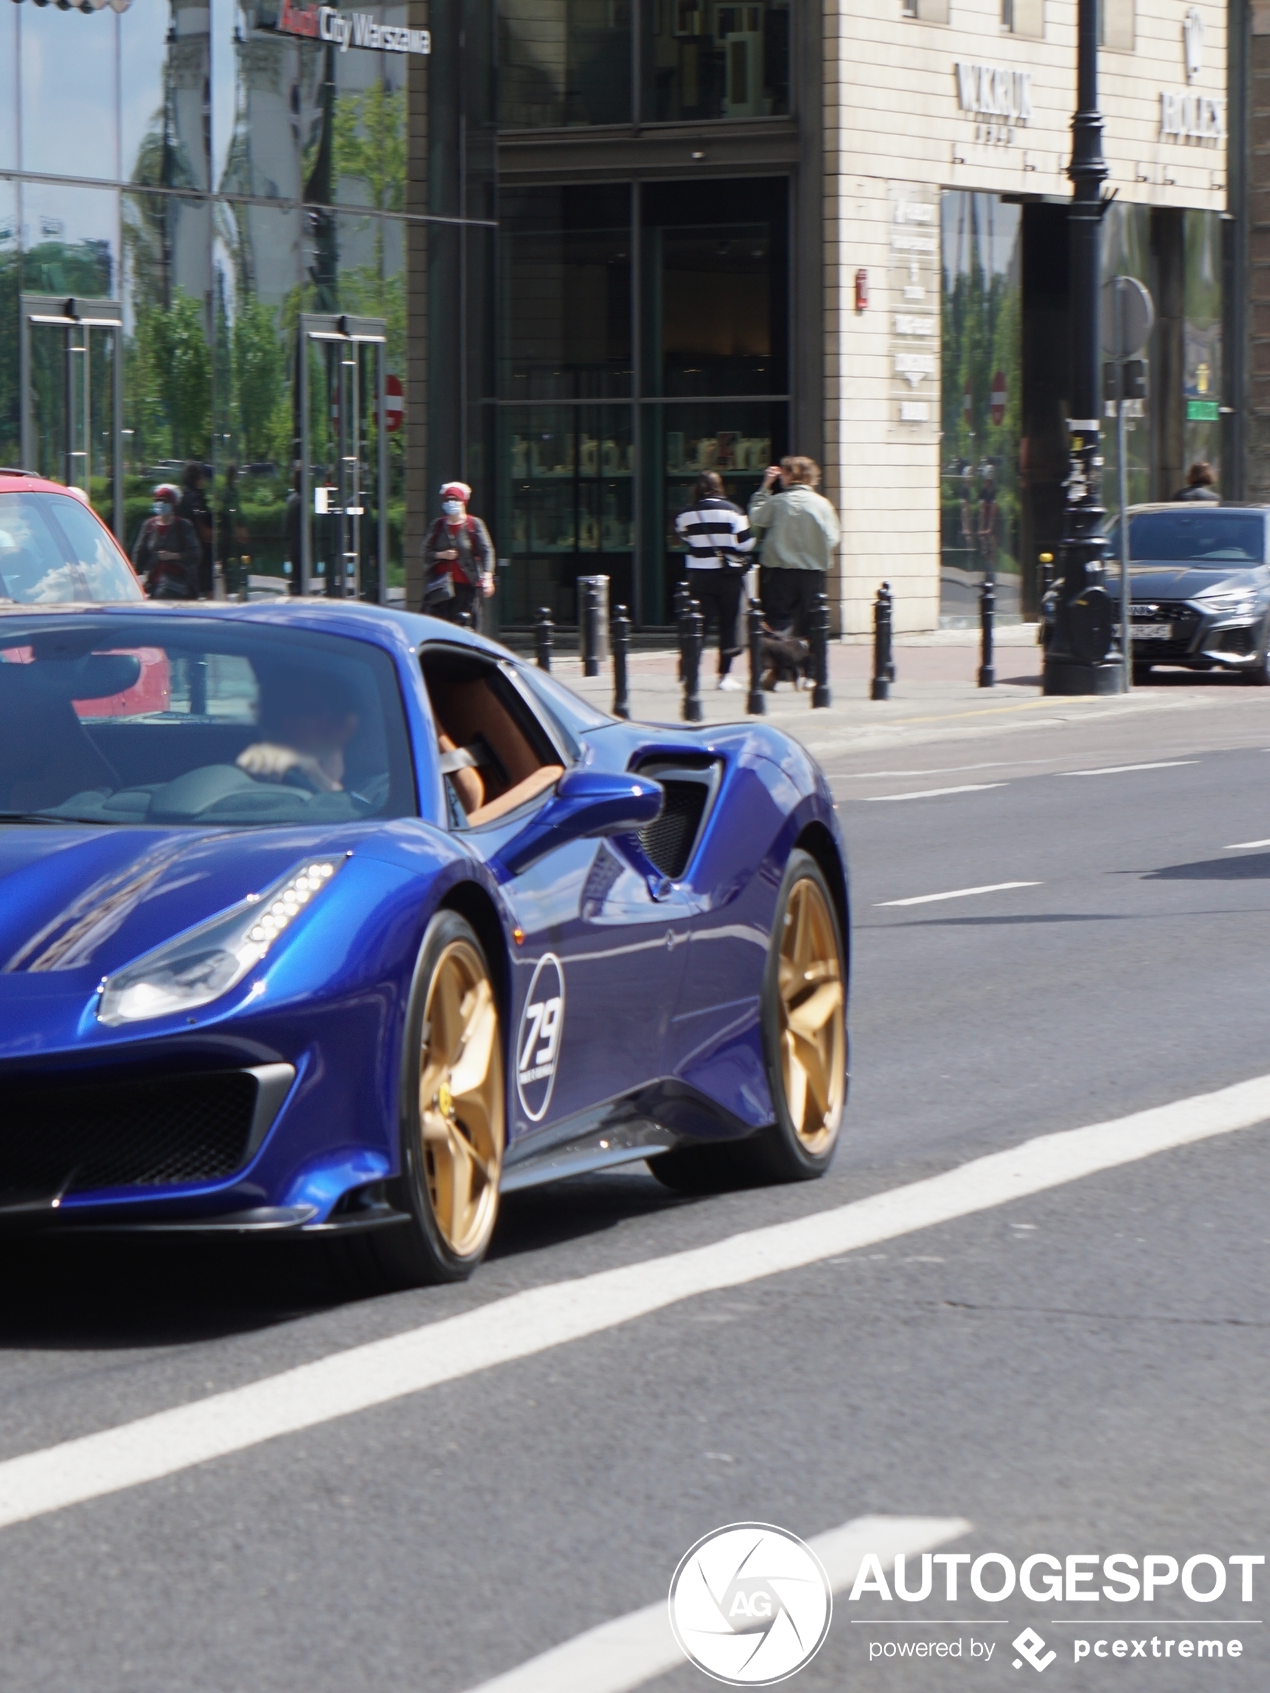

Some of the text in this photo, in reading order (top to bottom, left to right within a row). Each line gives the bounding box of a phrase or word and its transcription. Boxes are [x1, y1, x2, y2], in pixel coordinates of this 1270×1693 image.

[319, 6, 352, 53] City
[351, 12, 432, 55] Warszawa
[1159, 91, 1228, 138] ROLEX
[519, 996, 561, 1071] 79
